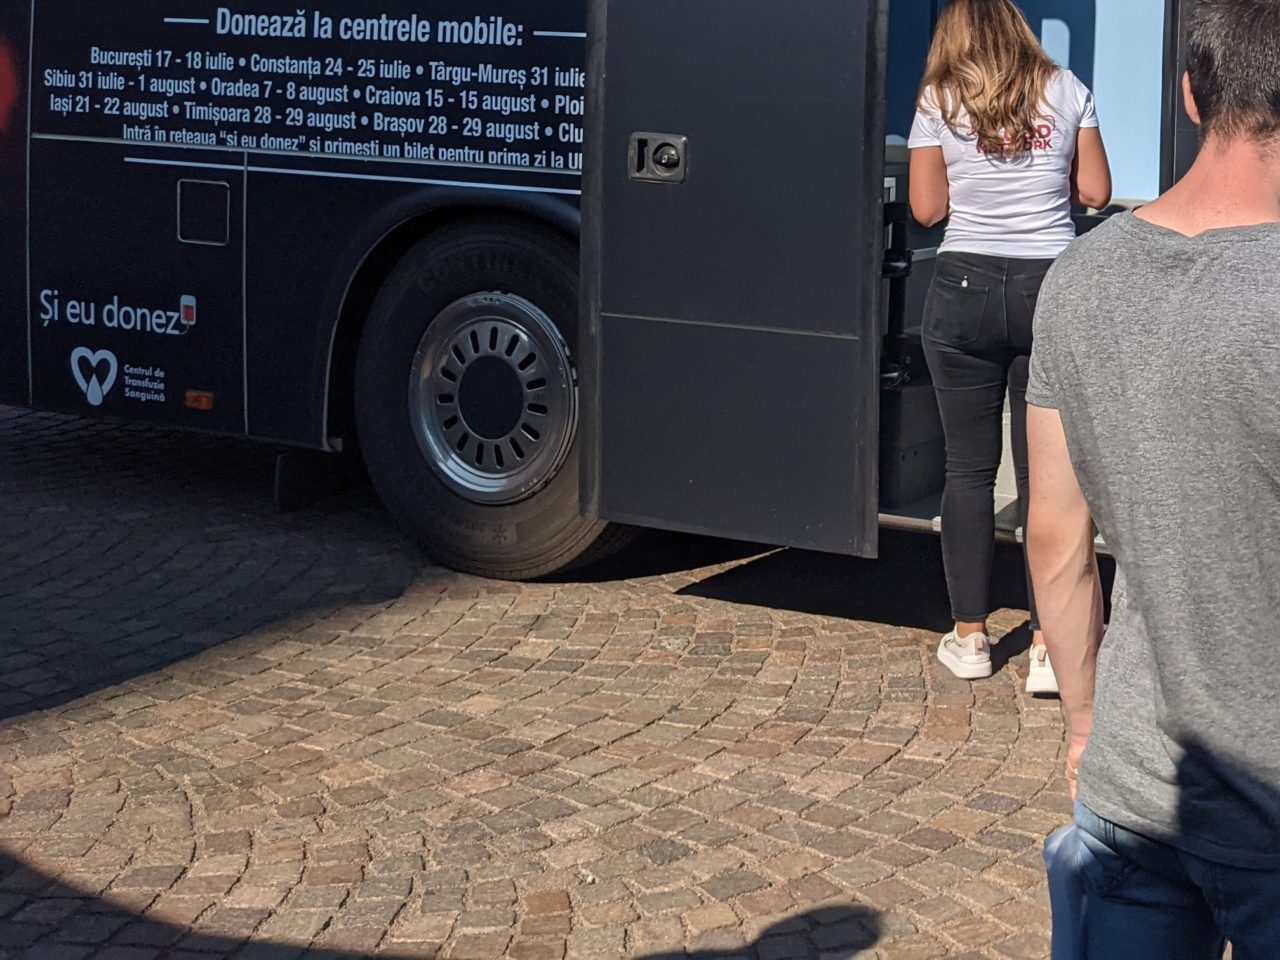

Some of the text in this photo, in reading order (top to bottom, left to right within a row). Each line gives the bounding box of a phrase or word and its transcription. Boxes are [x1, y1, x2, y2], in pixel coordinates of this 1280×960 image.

[216, 7, 523, 46] Donează la centrele mobile:
[90, 45, 153, 71] București
[156, 49, 173, 68] 17
[185, 51, 202, 70] 18
[205, 51, 235, 71] iulie
[250, 53, 321, 81] Constanța
[324, 57, 343, 76] 24
[357, 58, 376, 78] 25
[380, 59, 411, 79] iulie
[428, 60, 527, 91] Târgu-Mureș
[530, 66, 549, 86] 31
[44, 68, 75, 88] Sibiu
[79, 70, 93, 89] 31
[98, 71, 125, 91] iulie
[138, 73, 145, 92] 1
[150, 76, 196, 97] august
[211, 77, 260, 98] Oradea
[263, 80, 273, 98] 7
[286, 81, 296, 100] 8
[299, 84, 349, 106] august
[365, 85, 421, 107] Craiova
[425, 88, 444, 108] 15
[460, 90, 478, 110] 15
[482, 94, 536, 116] august
[555, 94, 584, 116] Ploi
[50, 93, 73, 117] Iași
[75, 95, 91, 113] 21
[104, 96, 120, 115] 22
[123, 100, 169, 121] august
[184, 101, 251, 127] Timișoara
[254, 105, 272, 125] 28
[285, 107, 304, 127] 29
[306, 110, 357, 132] august
[373, 111, 424, 138] Brașov
[428, 115, 447, 135] 28
[462, 117, 482, 137] 29
[485, 121, 540, 143] august
[558, 122, 584, 144] Clu
[123, 123, 152, 141] Intră
[154, 125, 167, 142] în
[240, 134, 257, 148] eu
[383, 144, 401, 159] un
[404, 141, 435, 160] bilet
[534, 150, 546, 167] zi
[551, 151, 564, 169] la
[39, 288, 181, 336] Și eu donez
[124, 364, 165, 378] Centrul de
[124, 375, 165, 390] Transfuzie
